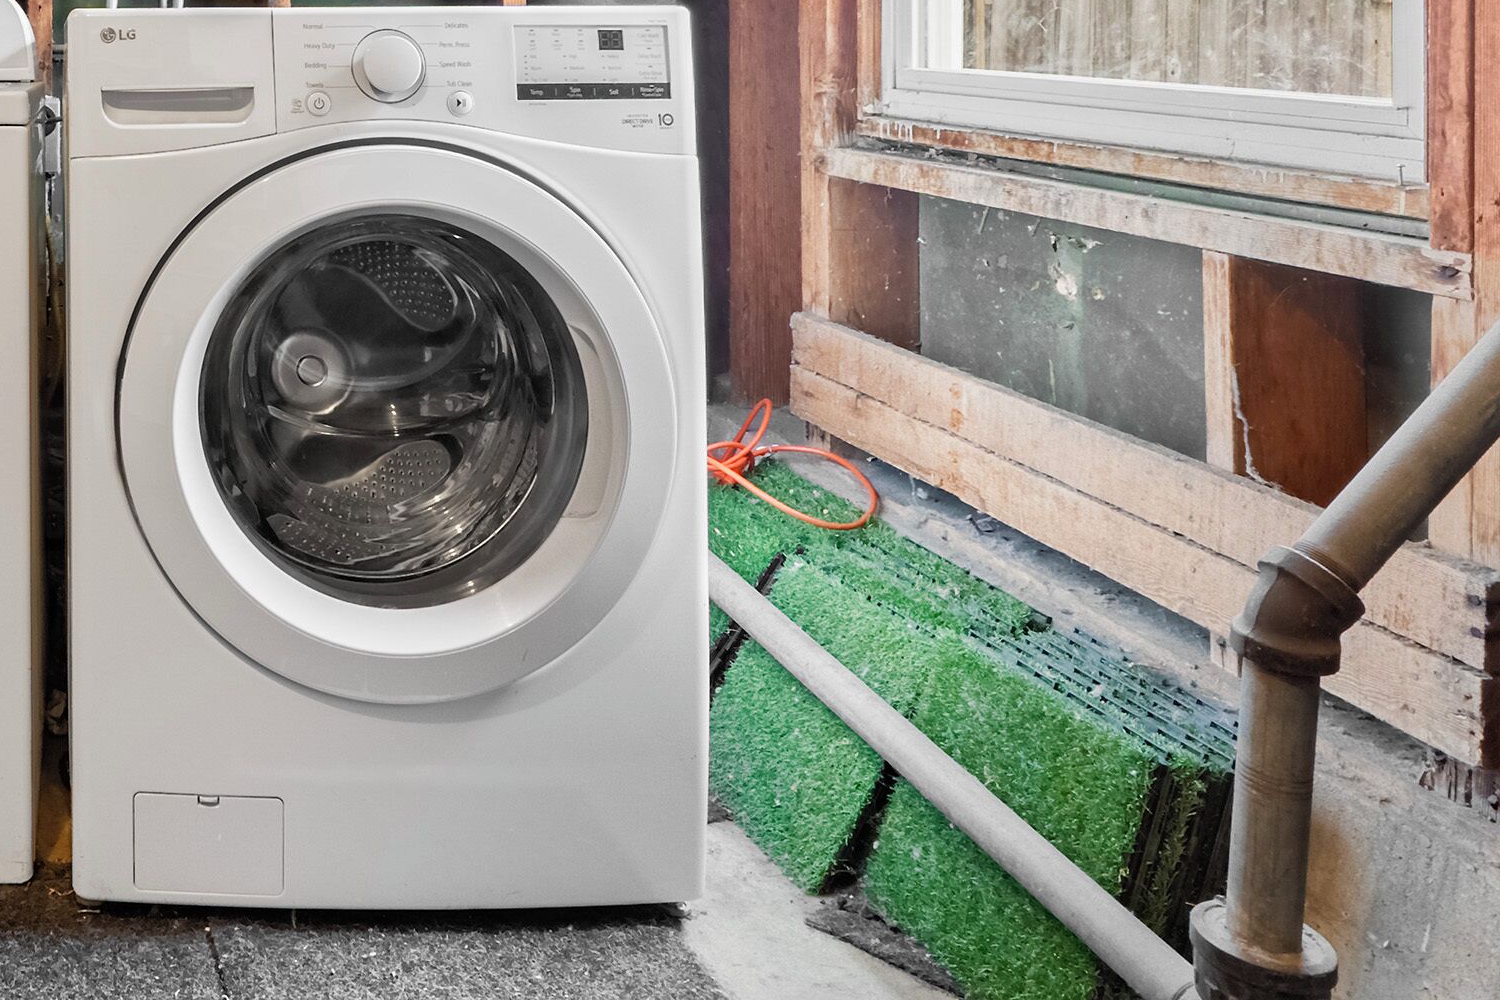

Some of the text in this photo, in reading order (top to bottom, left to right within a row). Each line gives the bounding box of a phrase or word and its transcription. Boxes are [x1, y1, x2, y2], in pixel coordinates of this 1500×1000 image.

[119, 29, 136, 41] LG
[305, 62, 327, 70] Bedding
[658, 113, 674, 126] 10
